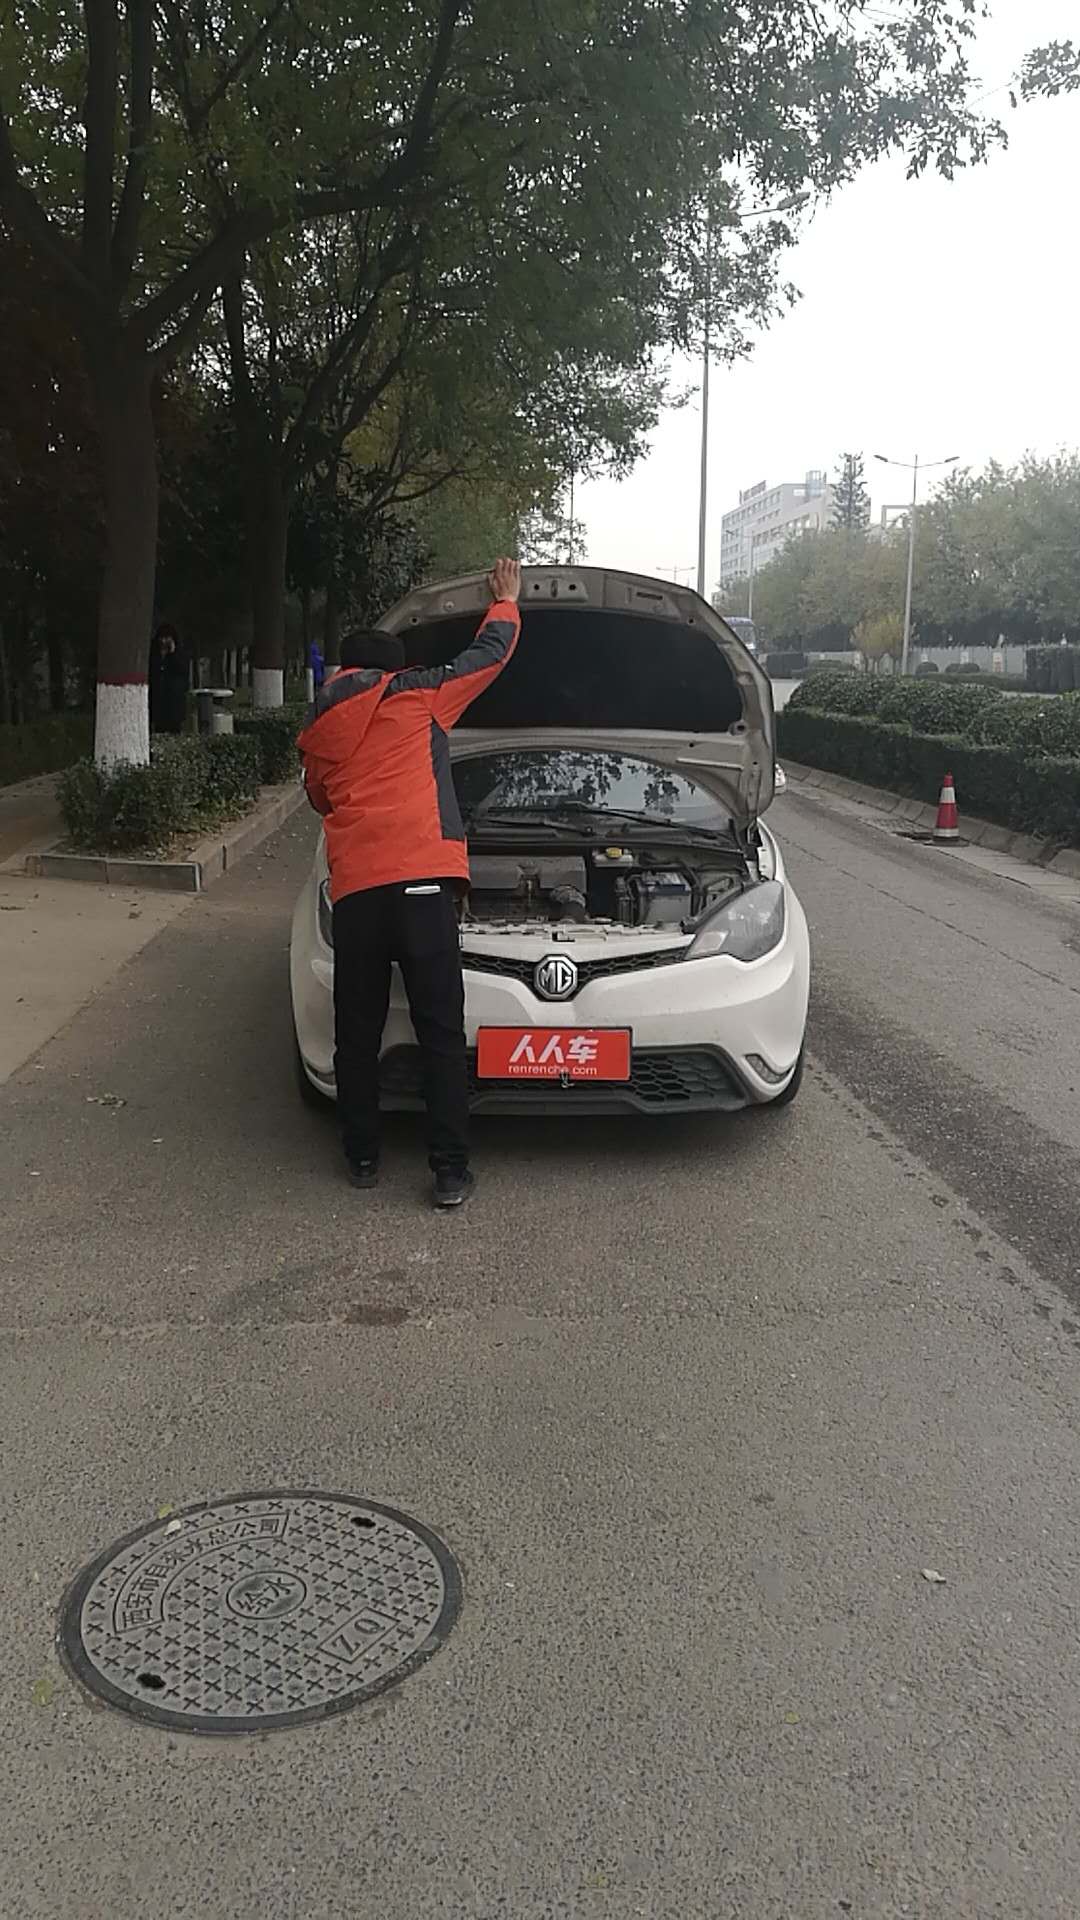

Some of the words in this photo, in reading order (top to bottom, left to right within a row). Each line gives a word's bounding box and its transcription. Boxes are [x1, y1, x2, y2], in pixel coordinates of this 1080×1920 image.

[541, 961, 573, 993] MG
[509, 1034, 600, 1064] 人人车
[508, 1064, 598, 1075] renrenche.com
[122, 1518, 280, 1629] 西安市自来水总公司
[236, 1576, 296, 1615] 给水
[331, 1617, 386, 1656] ZQ
